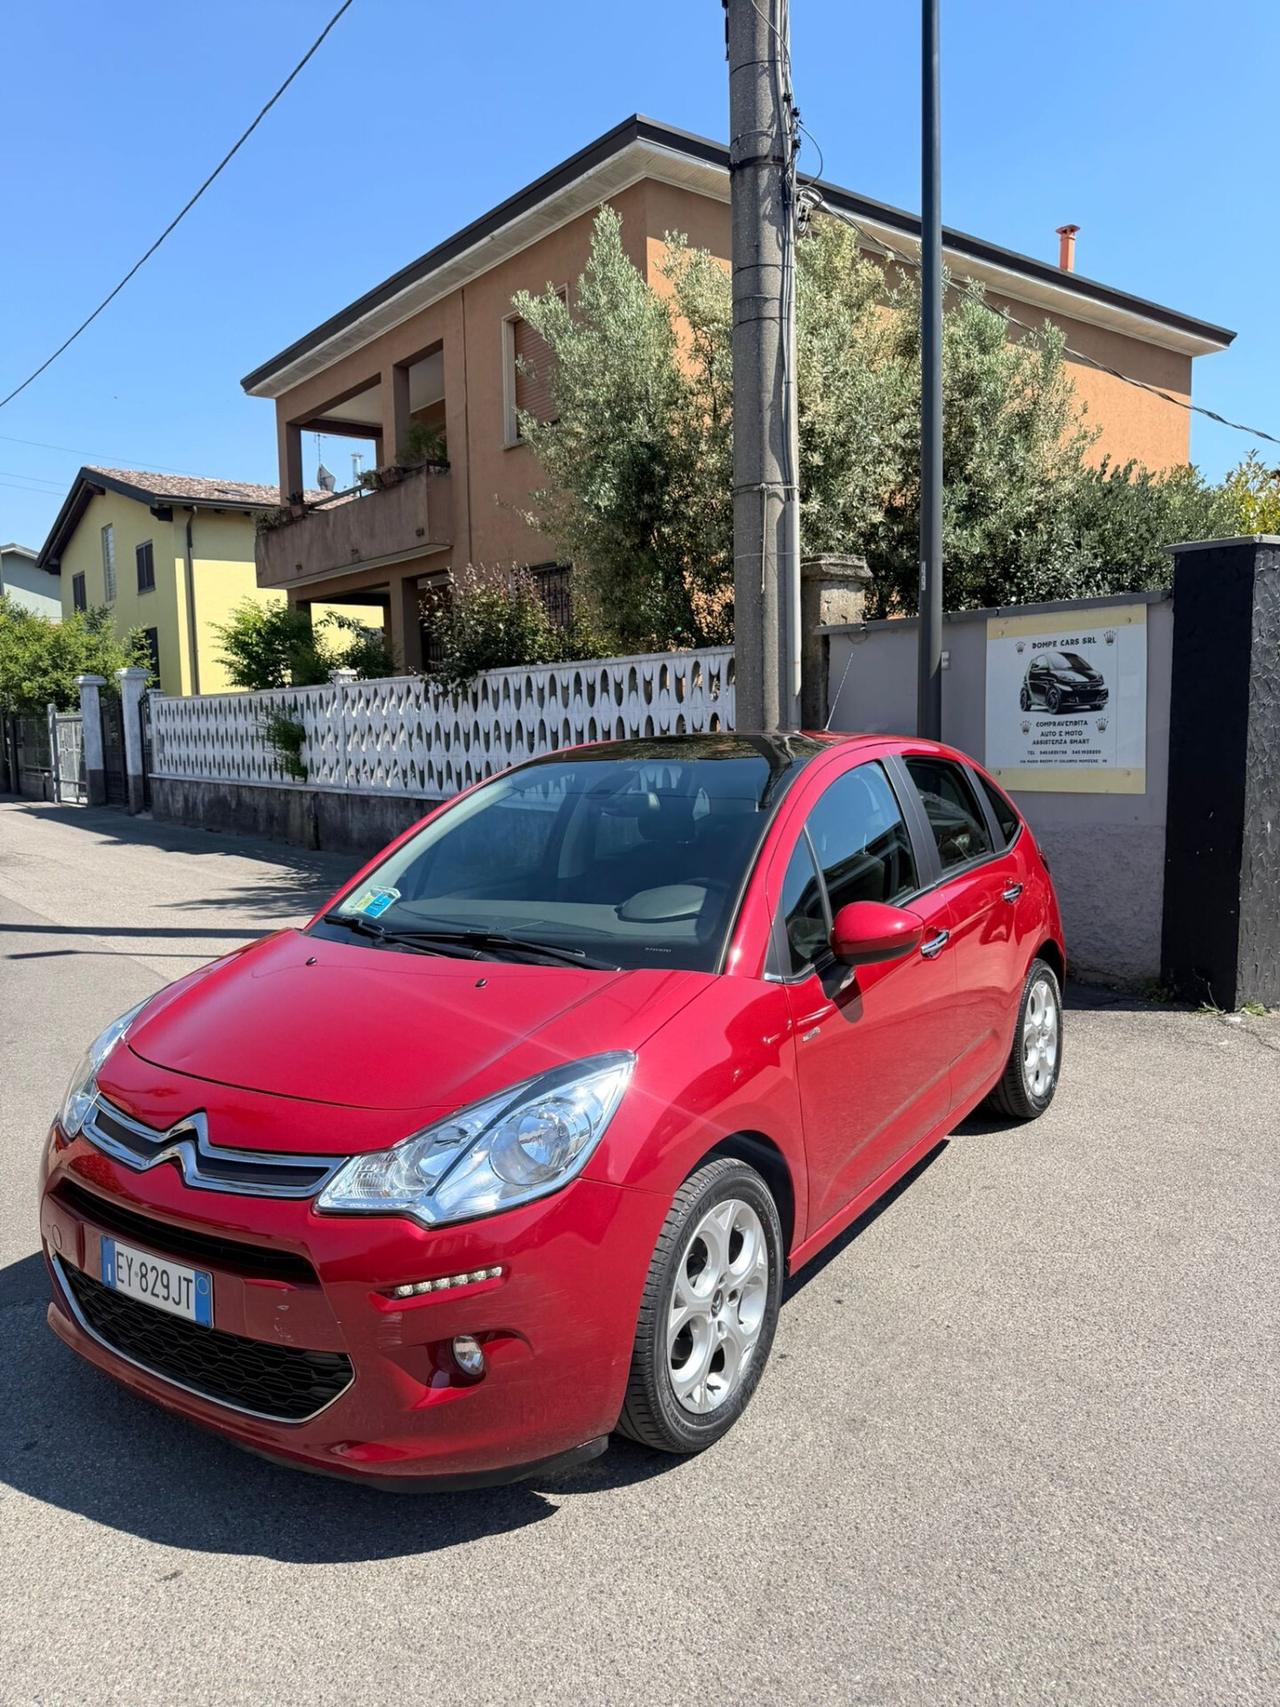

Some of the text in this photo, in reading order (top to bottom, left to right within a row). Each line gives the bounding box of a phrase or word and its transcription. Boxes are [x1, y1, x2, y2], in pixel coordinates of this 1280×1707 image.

[1060, 638, 1079, 646] CARS
[1082, 636, 1096, 644] SRL
[1036, 720, 1088, 728] COMPRAVENDITA
